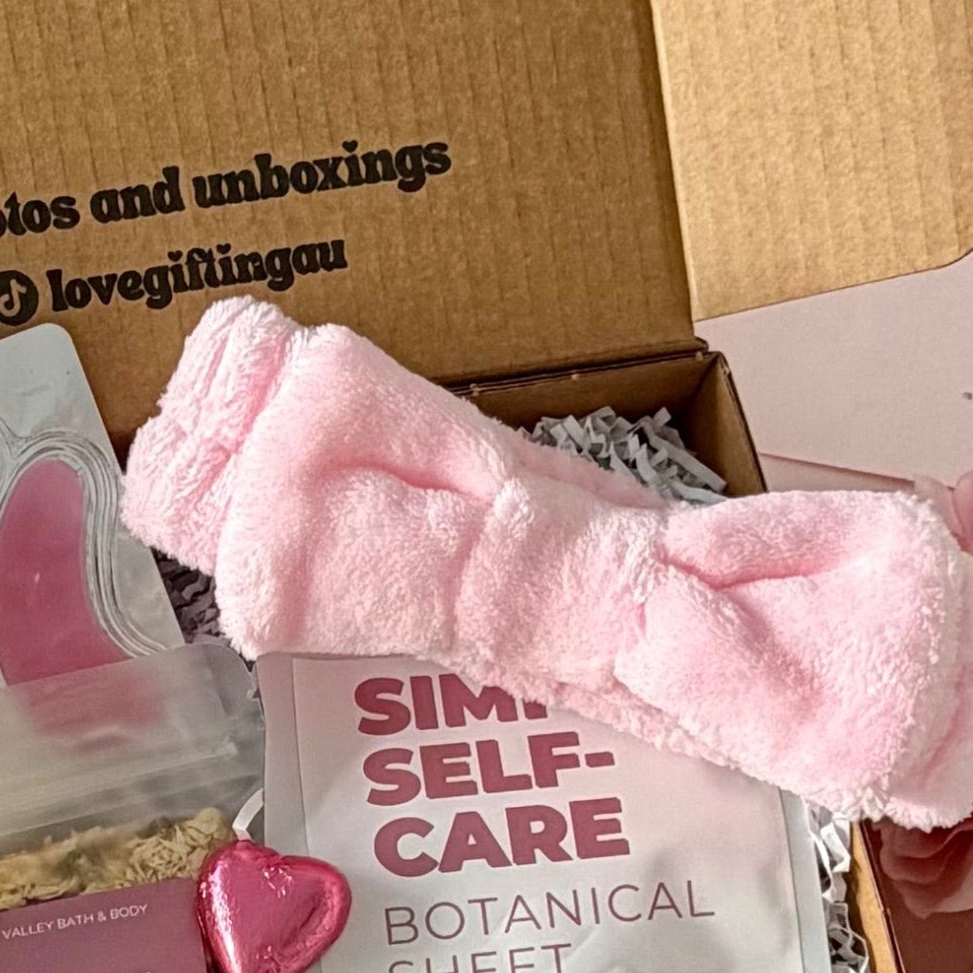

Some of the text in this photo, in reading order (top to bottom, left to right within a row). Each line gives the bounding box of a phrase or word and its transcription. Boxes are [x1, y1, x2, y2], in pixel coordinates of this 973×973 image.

[91, 166, 185, 225] and
[193, 140, 452, 208] unboxings
[46, 239, 347, 309] lovegiftingau
[354, 673, 547, 736] SIM
[362, 731, 615, 807] SELF-
[373, 797, 630, 877] CARE
[2, 921, 55, 941] VALLEY
[57, 912, 95, 931] BATH
[97, 910, 107, 923] &
[110, 903, 149, 921] BODY
[384, 880, 715, 946] BOTANICAL
